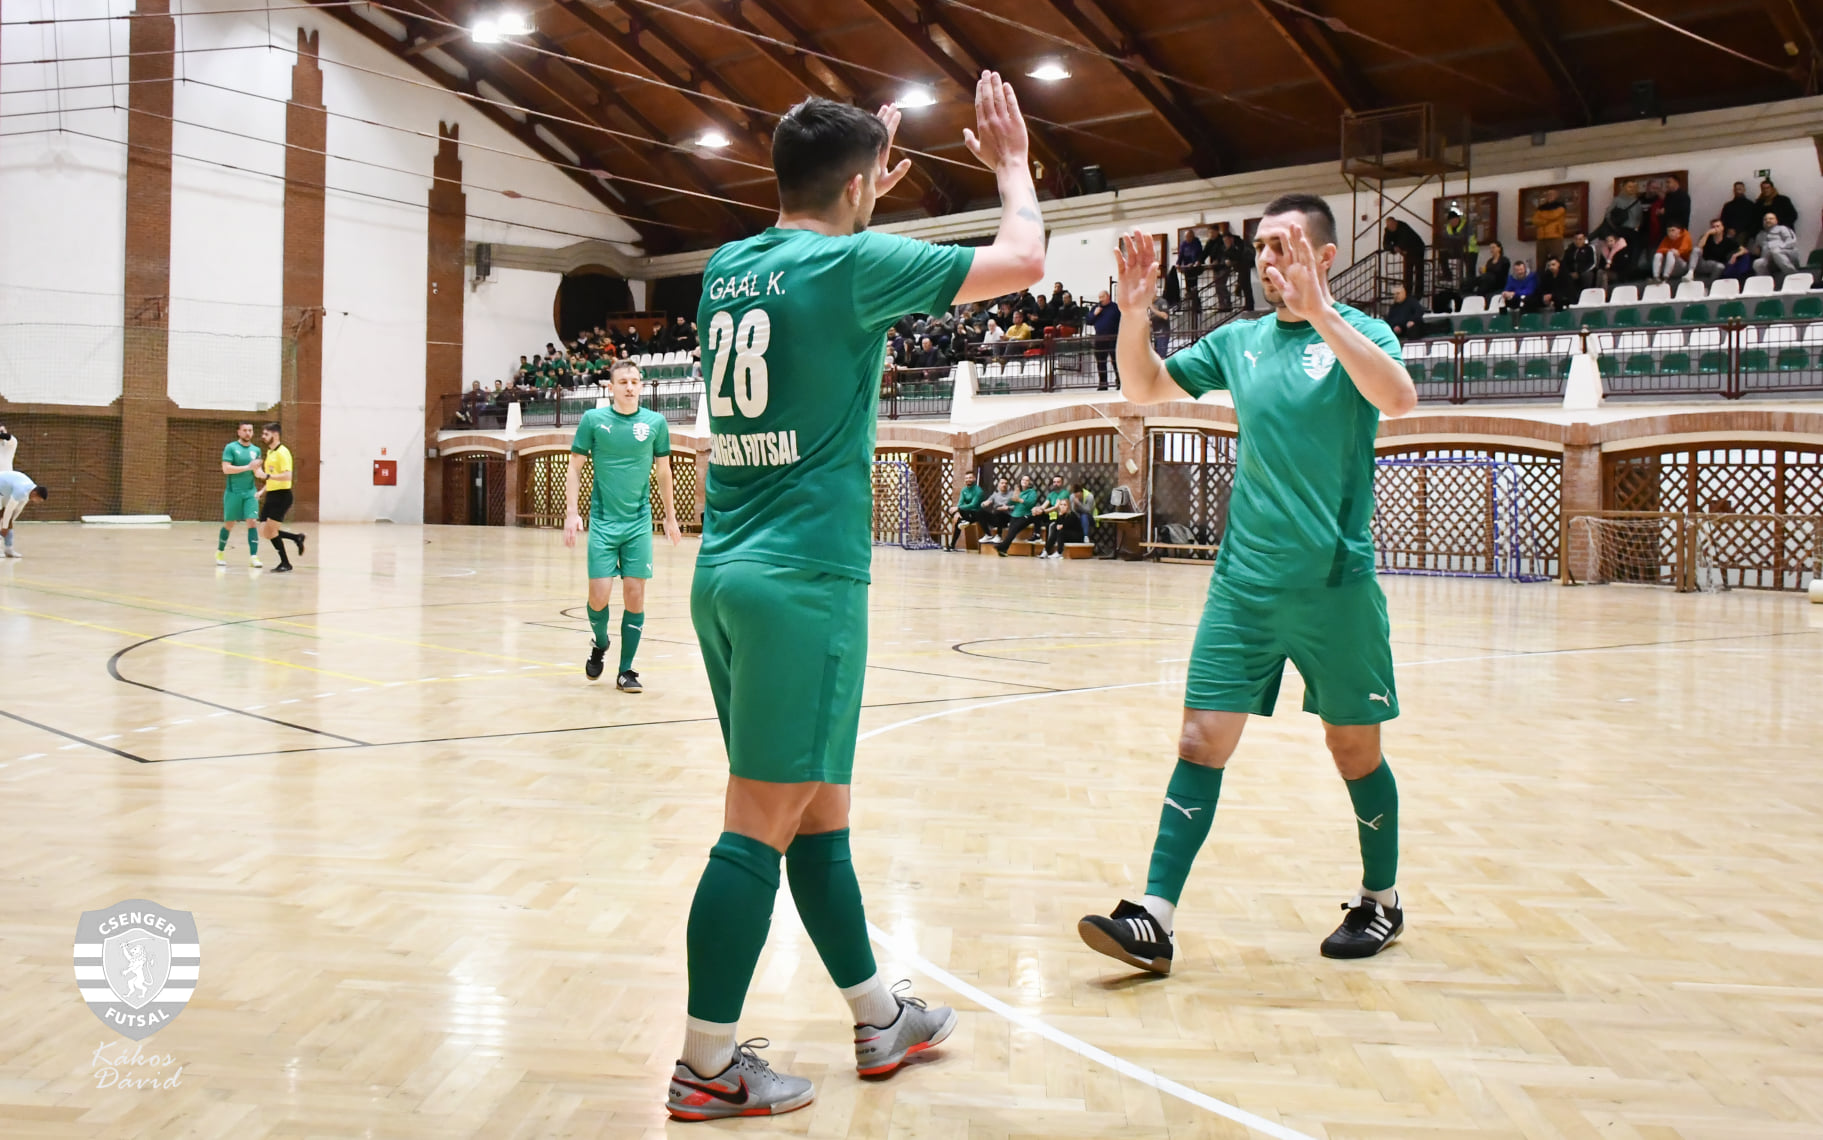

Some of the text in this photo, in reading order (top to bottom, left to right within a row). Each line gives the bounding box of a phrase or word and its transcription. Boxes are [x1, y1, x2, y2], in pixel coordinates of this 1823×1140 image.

[709, 271, 786, 300] GAÁL K.
[708, 308, 771, 418] 28
[740, 430, 801, 467] FUTSAL
